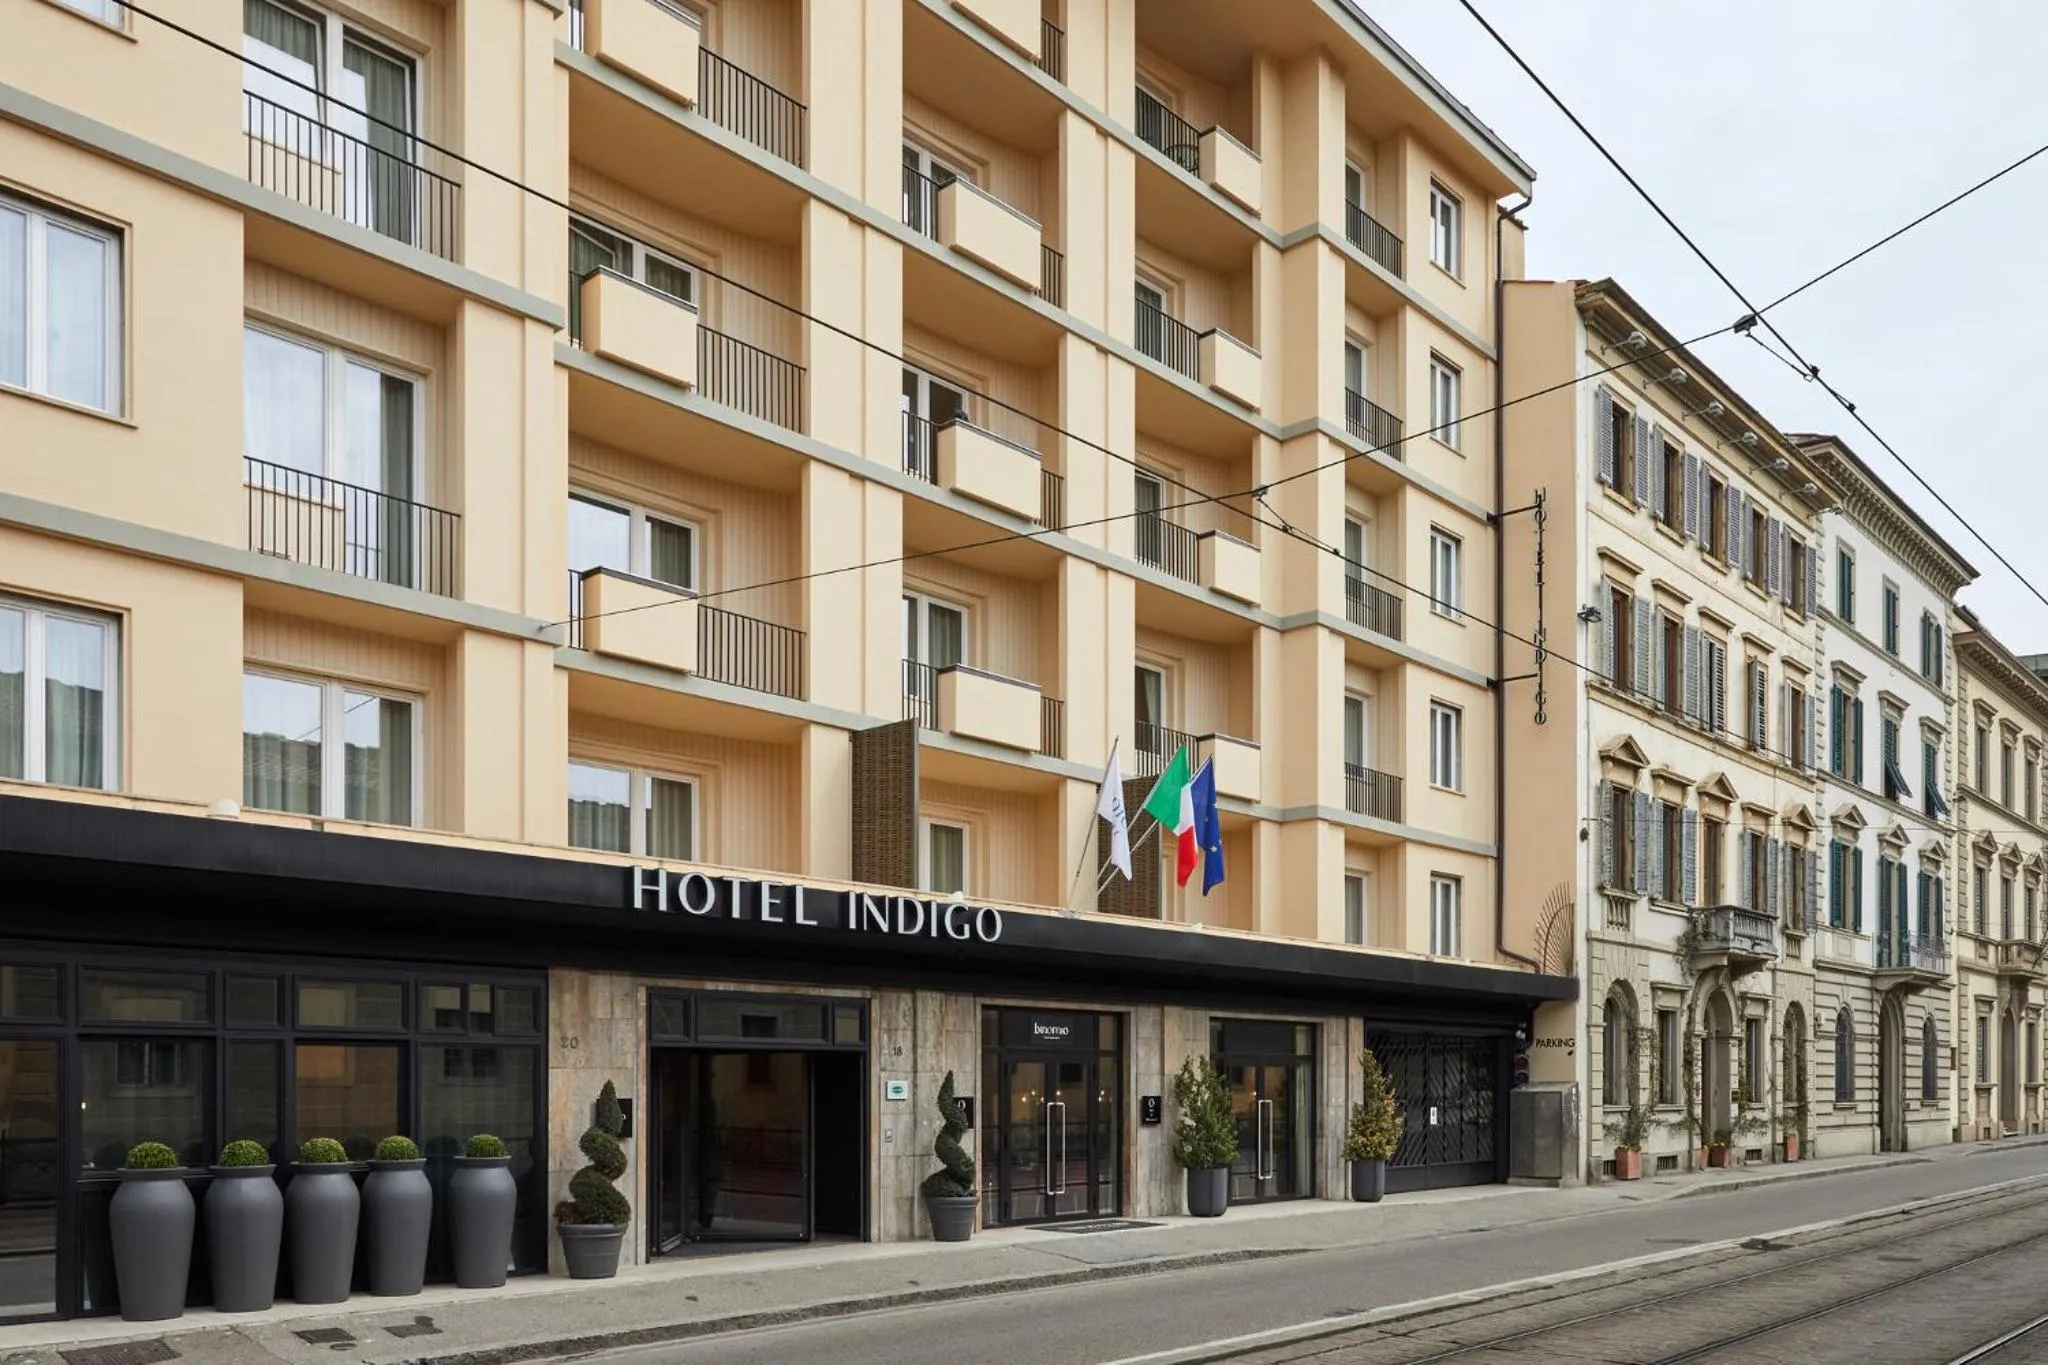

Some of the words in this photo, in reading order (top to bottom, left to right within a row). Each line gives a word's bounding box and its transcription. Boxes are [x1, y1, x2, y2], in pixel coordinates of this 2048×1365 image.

[632, 865, 818, 926] HOTEL
[847, 890, 1003, 943] INDIGO
[561, 1036, 579, 1049] 20
[1536, 1038, 1575, 1048] PARKING
